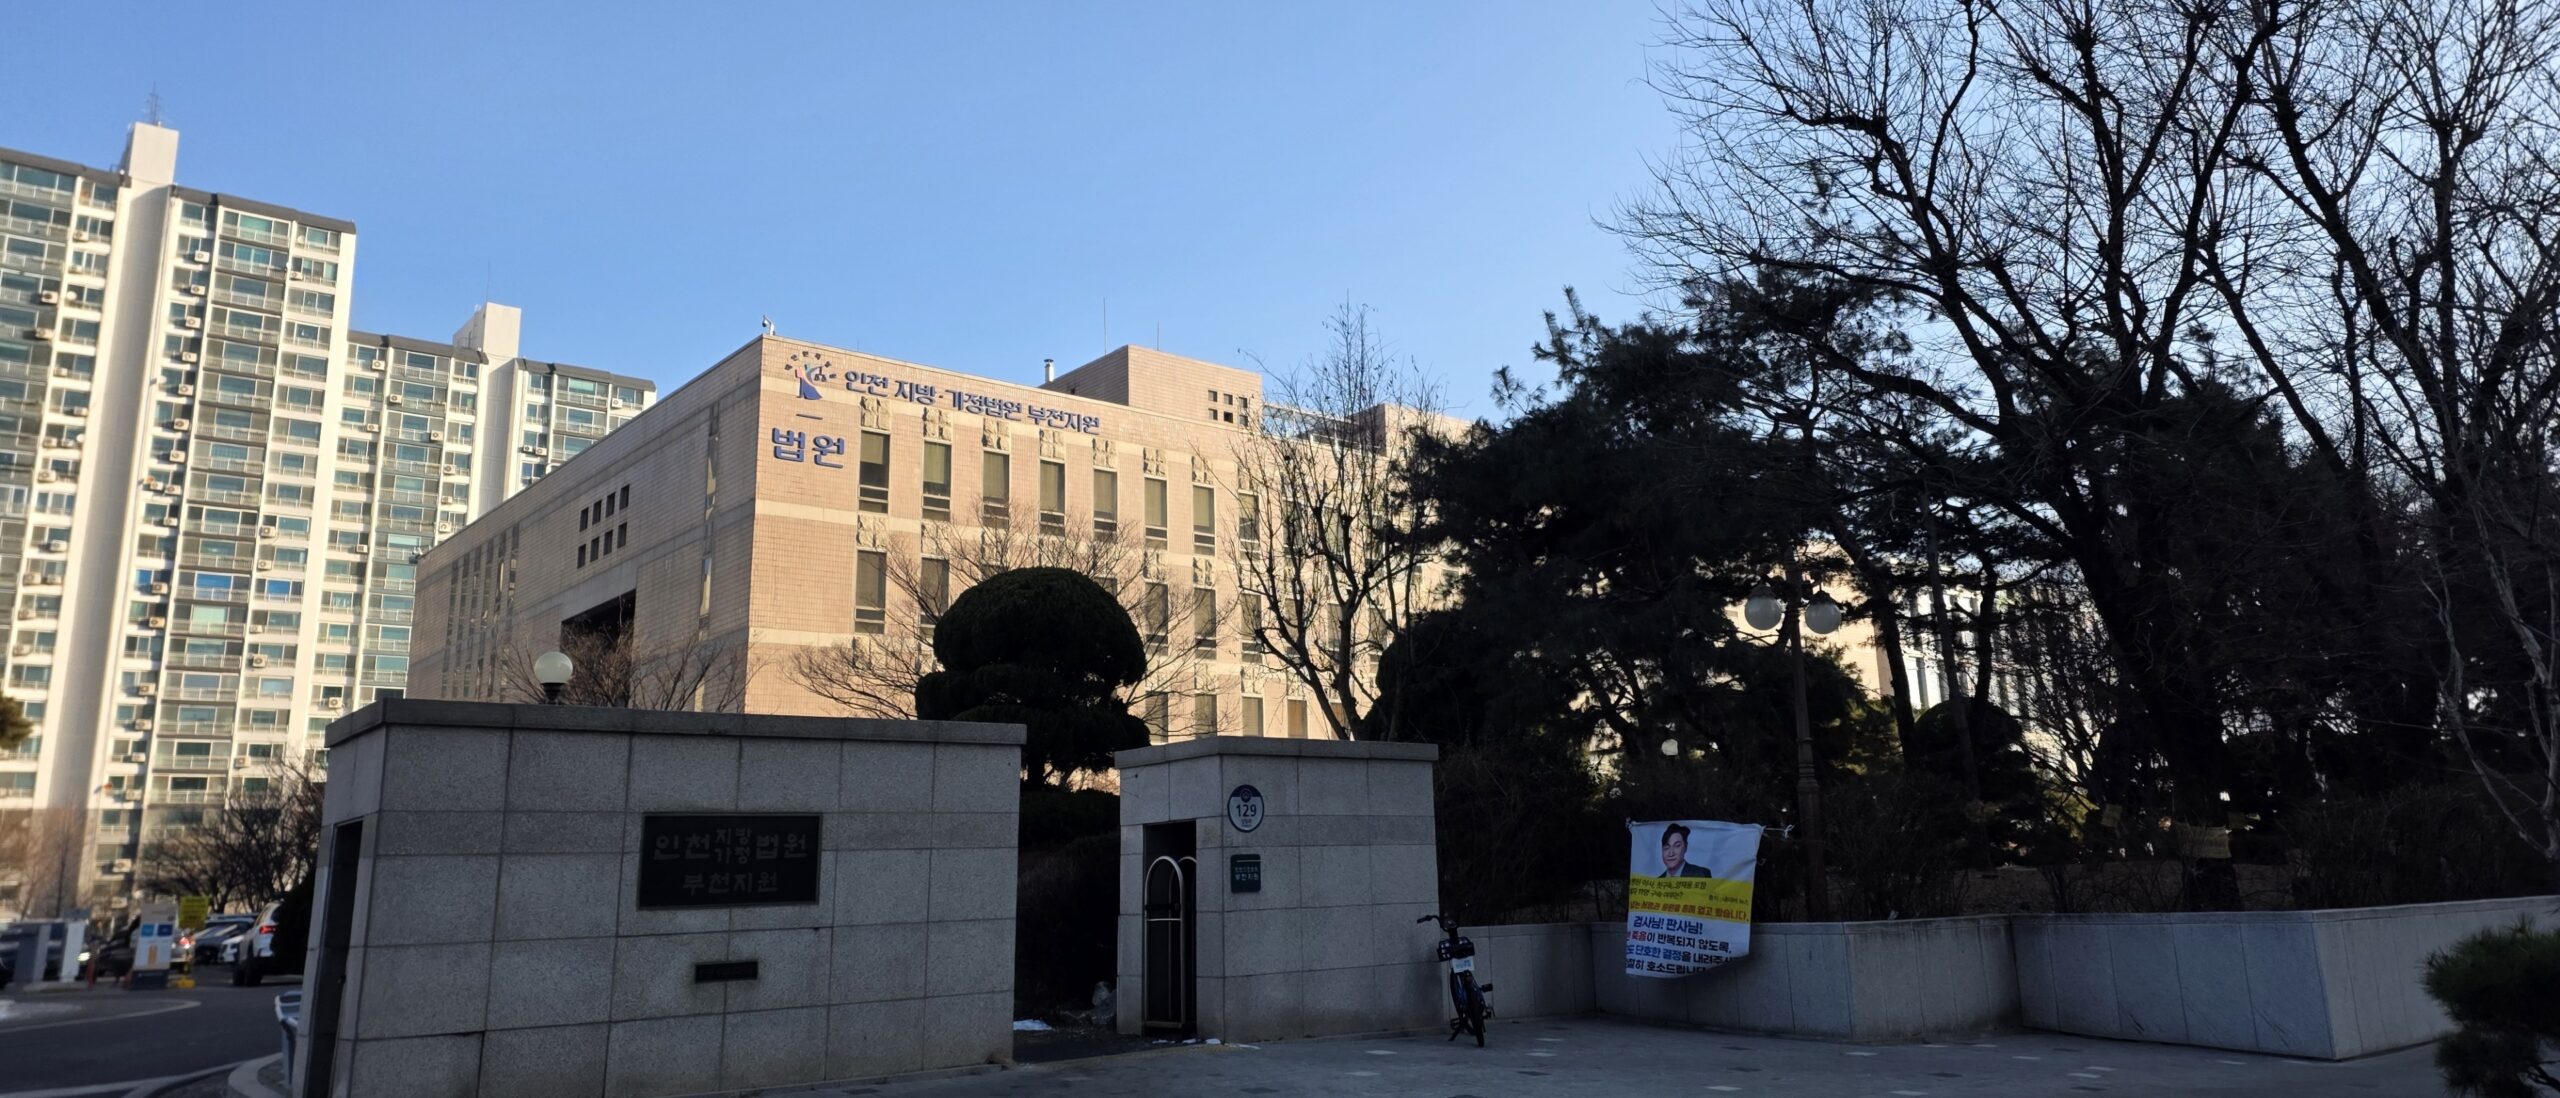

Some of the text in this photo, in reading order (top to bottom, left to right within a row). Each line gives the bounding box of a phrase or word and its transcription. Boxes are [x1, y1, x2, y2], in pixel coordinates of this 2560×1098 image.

[844, 370, 889, 397] 인천
[1027, 404, 1100, 434] 부천지원
[772, 427, 846, 469] 법원
[1236, 804, 1257, 817] 129
[653, 833, 711, 860] 인천
[755, 833, 808, 860] 법원
[682, 871, 779, 896] 부천지원
[1633, 915, 1703, 935] 검사님! 판사님!
[1657, 933, 1695, 948] 반복되지
[1698, 939, 1732, 954] 않도록,
[1663, 948, 1692, 963] 결정을
